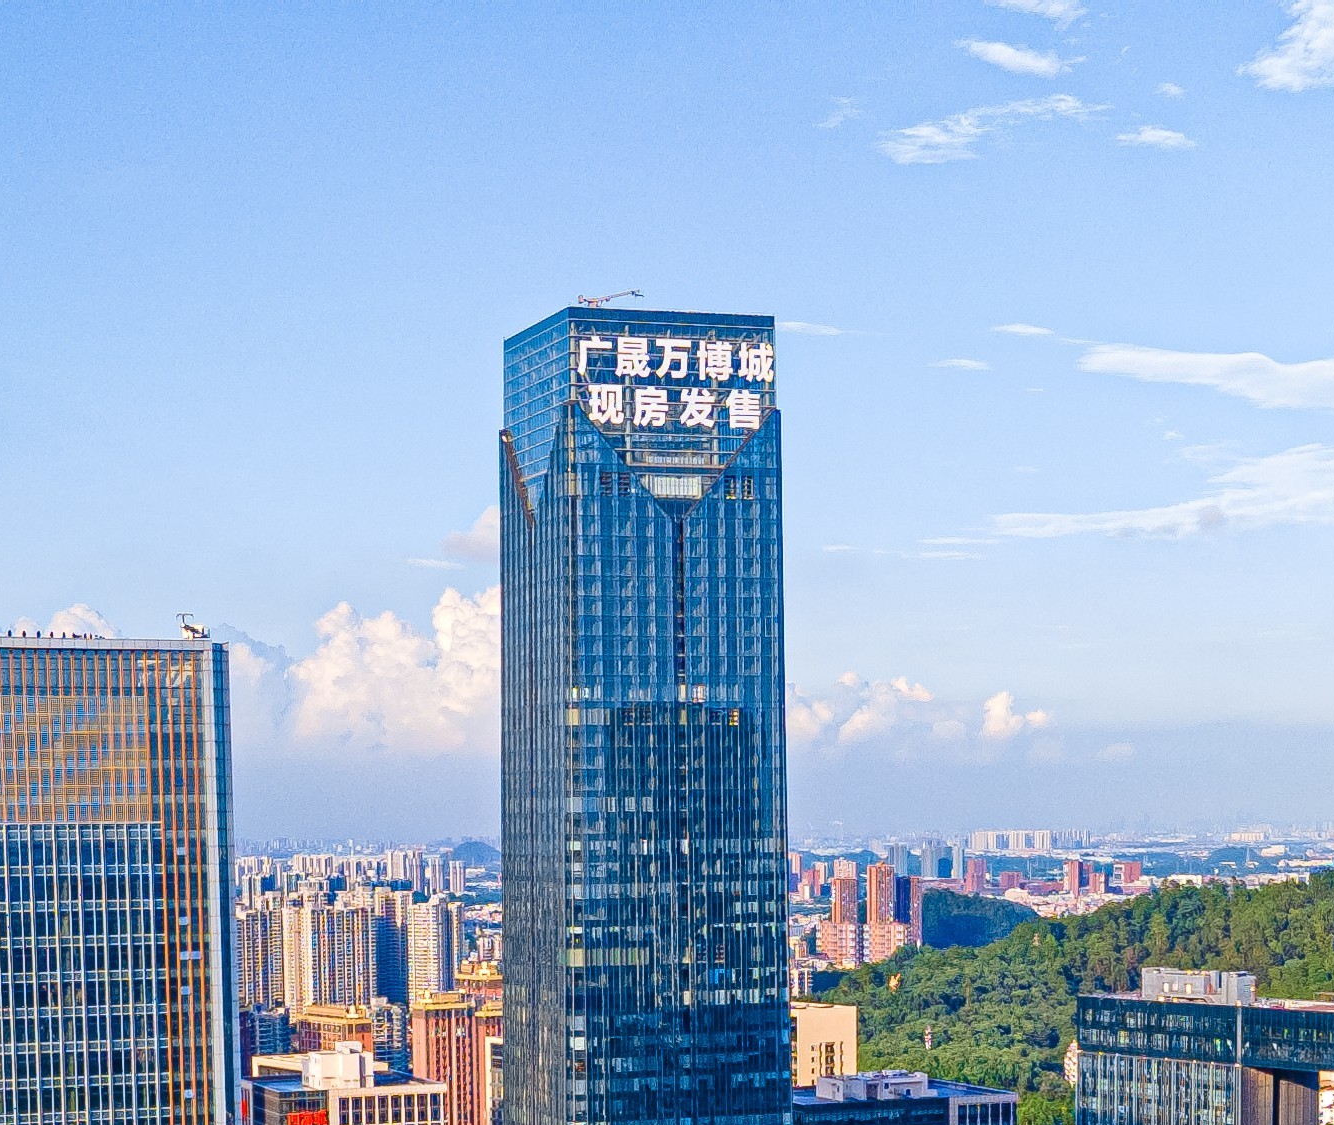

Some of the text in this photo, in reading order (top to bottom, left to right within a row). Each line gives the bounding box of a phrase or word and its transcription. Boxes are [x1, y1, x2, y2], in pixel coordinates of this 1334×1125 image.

[576, 336, 775, 383] 广晟万博城
[587, 383, 762, 430] 现房发售
